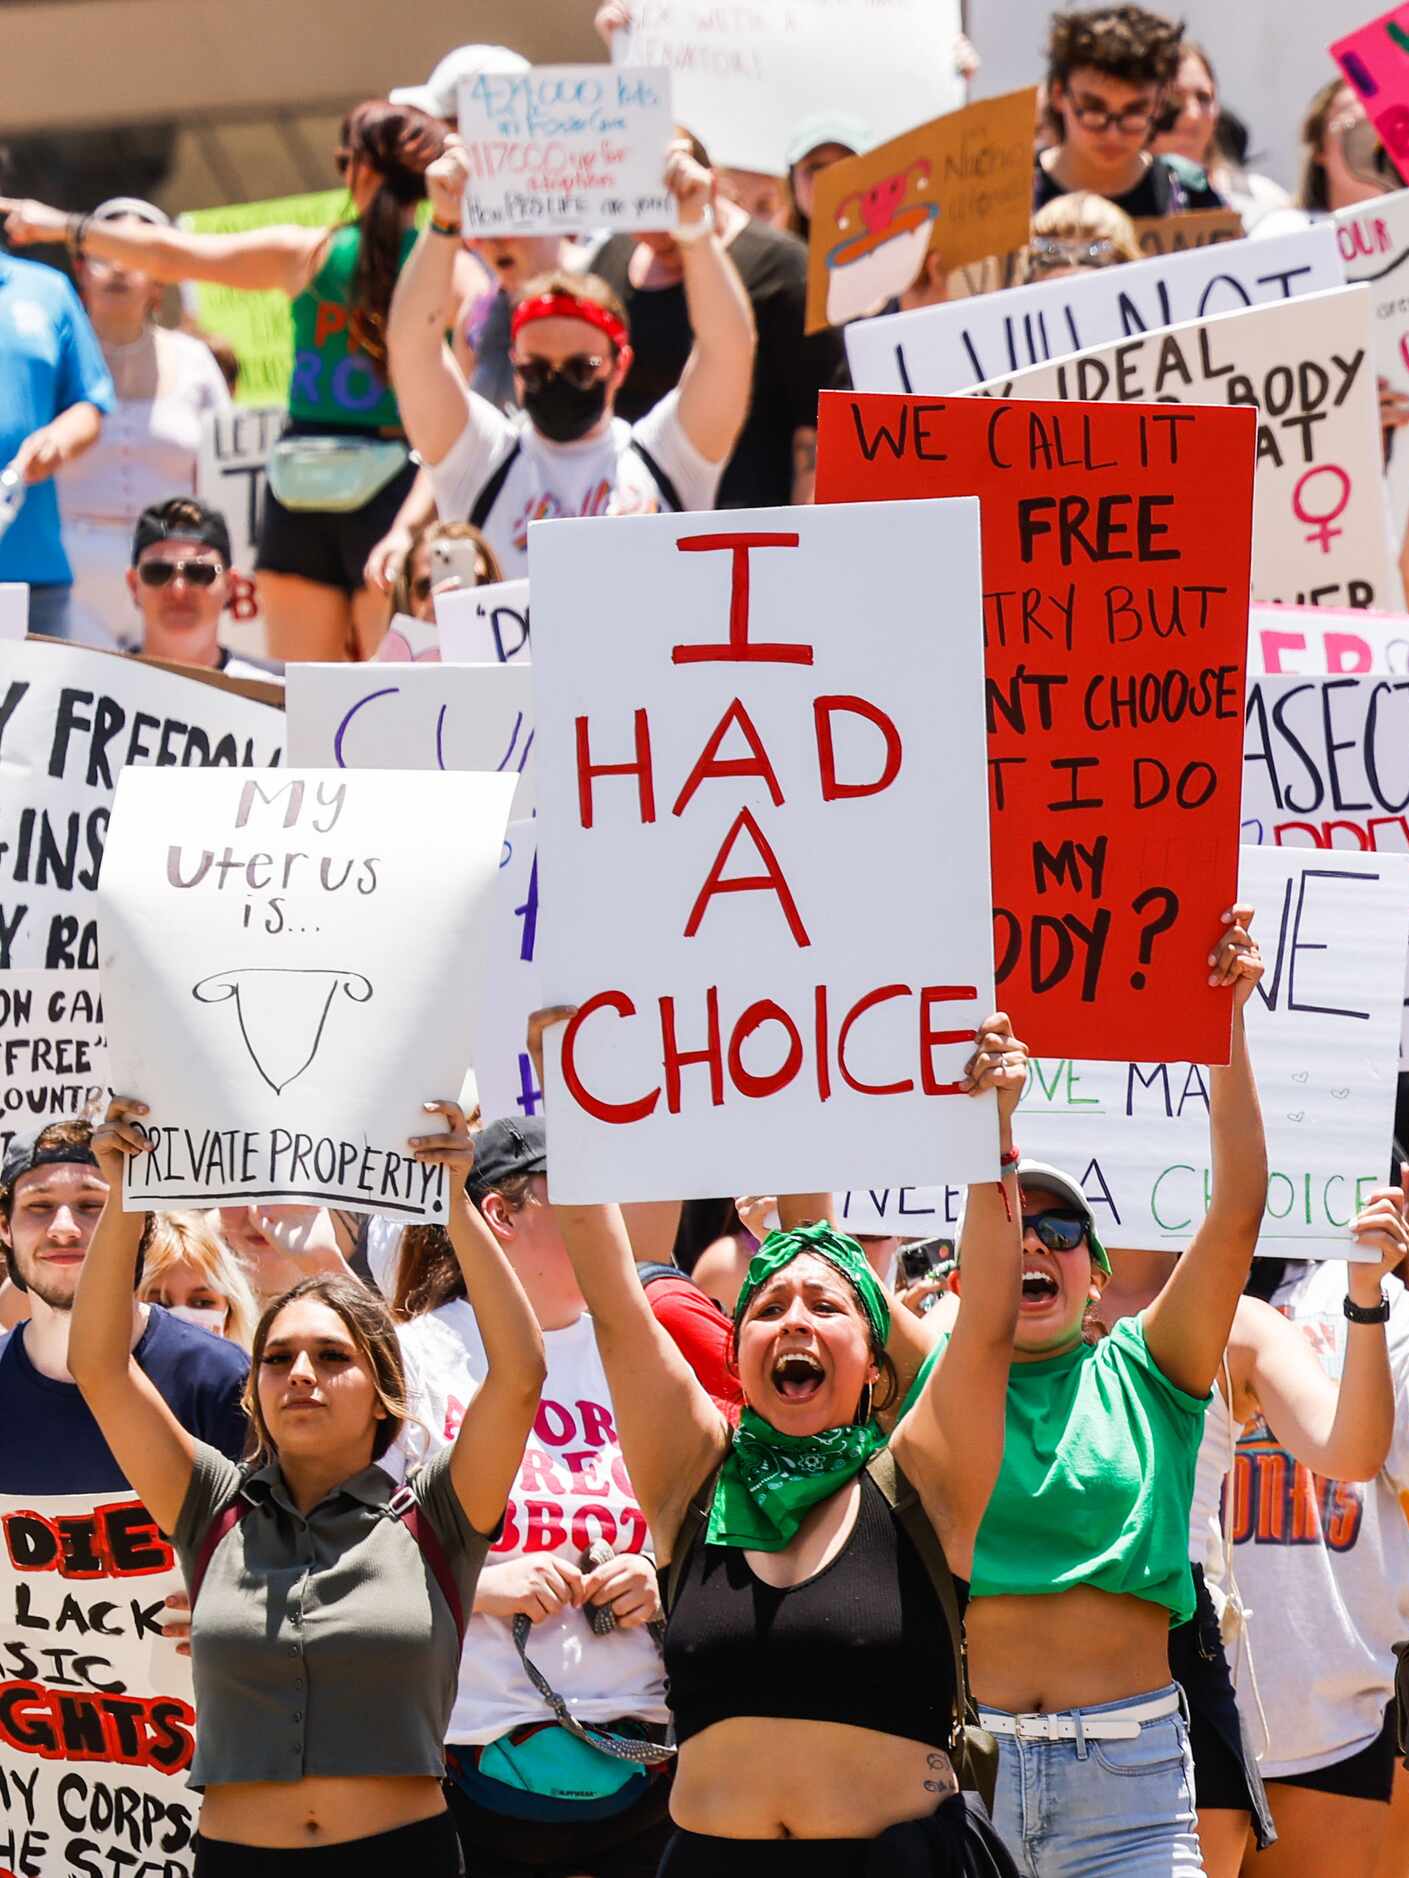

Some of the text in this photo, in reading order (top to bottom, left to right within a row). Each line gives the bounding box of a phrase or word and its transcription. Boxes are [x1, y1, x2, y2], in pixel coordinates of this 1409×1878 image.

[1057, 327, 1235, 402] IDEAL
[1226, 348, 1365, 418] BODY
[850, 403, 1197, 471] WE CALL IT
[1017, 494, 1182, 567] FREE
[671, 531, 814, 666] I
[983, 583, 1228, 651] TRY BUT
[1083, 664, 1239, 732] CHOOSE
[574, 694, 903, 829] HAD
[1046, 756, 1105, 812] I
[1132, 757, 1219, 810] DO
[234, 778, 347, 834] My
[683, 805, 812, 948] A
[1031, 834, 1109, 900] MY
[560, 983, 979, 1125] CHOICE
[127, 1120, 446, 1214] PRIVATE PROPERTY!
[1077, 1157, 1123, 1226] A
[3, 1502, 174, 1578] DIE
[0, 1640, 128, 1695] SIC
[57, 1771, 198, 1855] CORPS
